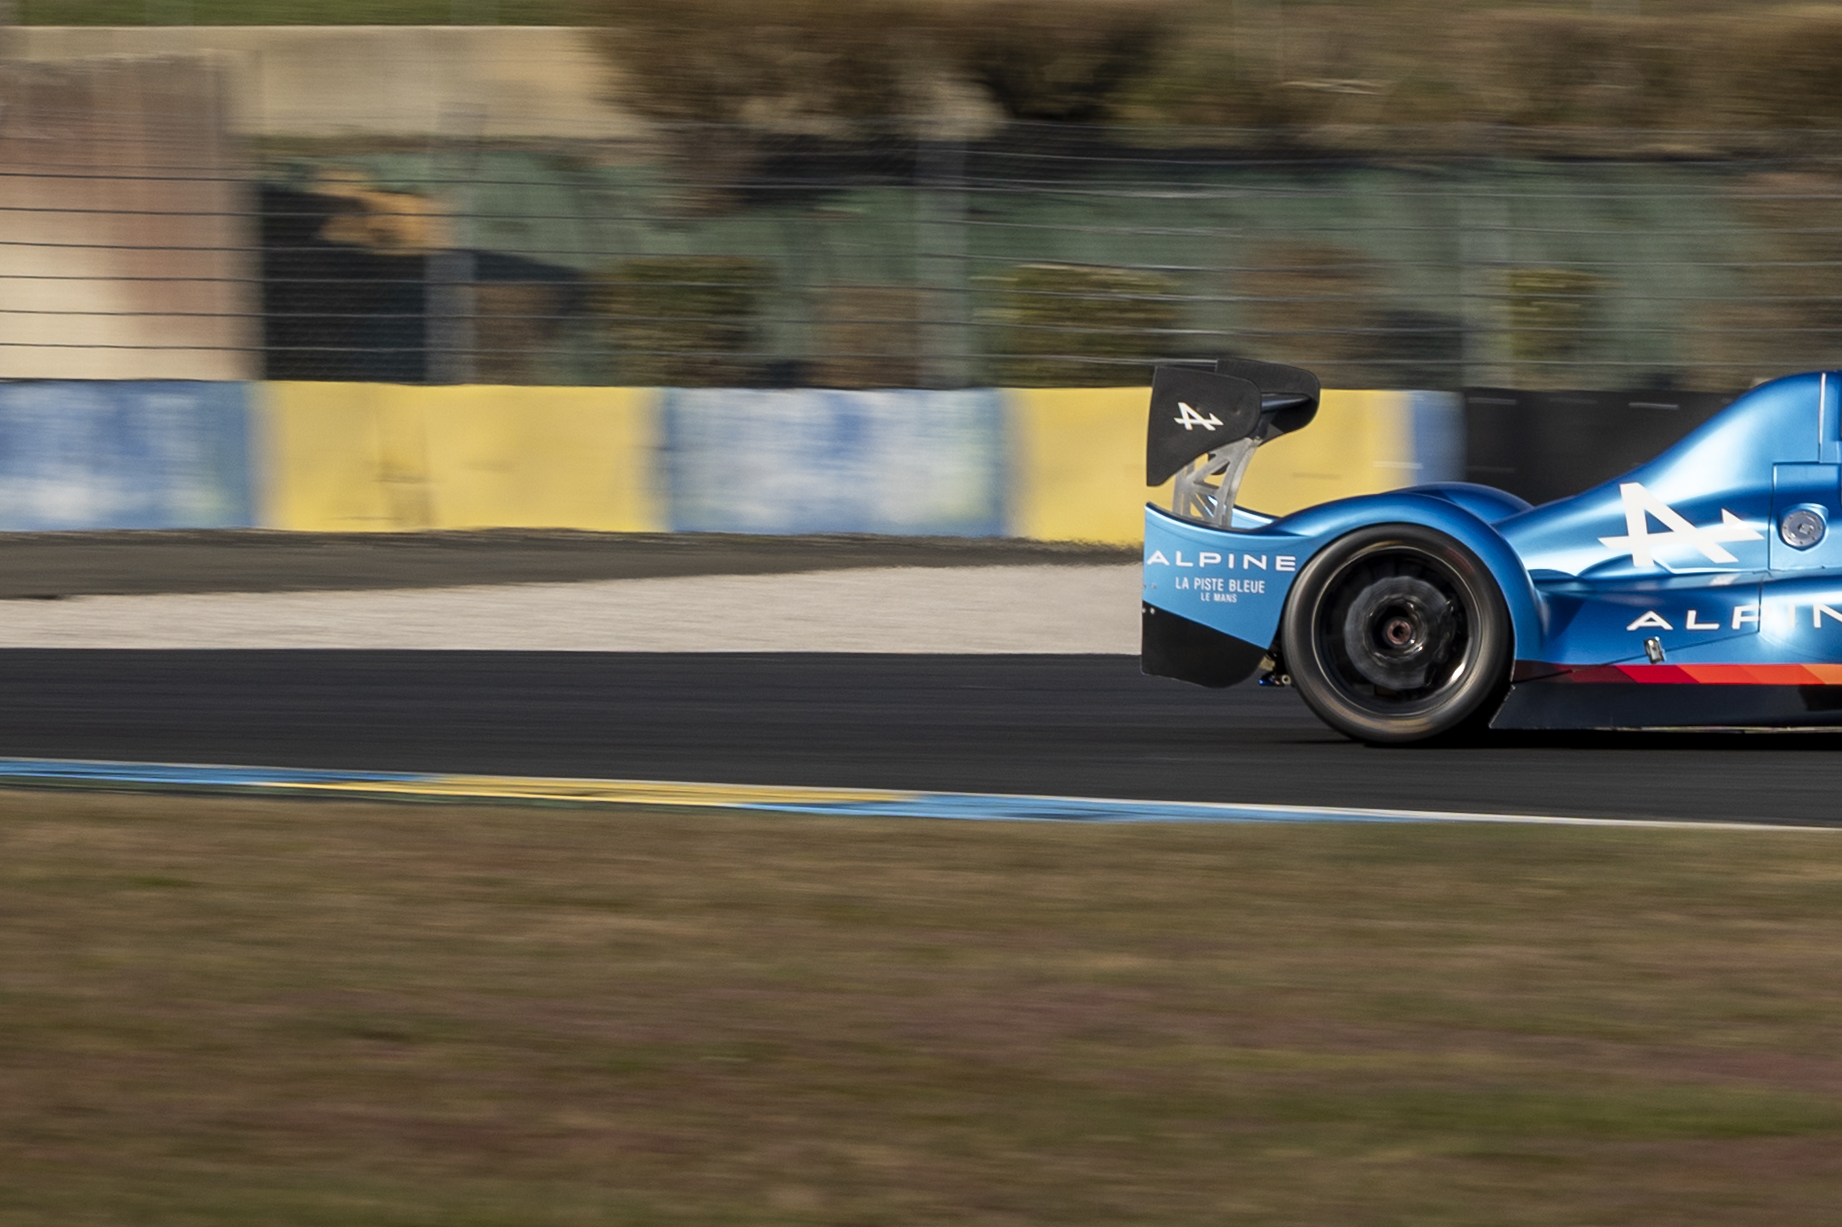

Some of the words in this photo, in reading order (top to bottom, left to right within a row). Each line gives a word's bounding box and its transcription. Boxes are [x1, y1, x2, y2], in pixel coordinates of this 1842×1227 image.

[1147, 550, 1296, 572] ALPINE
[1175, 576, 1189, 590] LA
[1194, 577, 1224, 592] PISTE
[1229, 579, 1266, 594] BLEUE
[1200, 592, 1211, 602] LE
[1213, 593, 1238, 603] MANS
